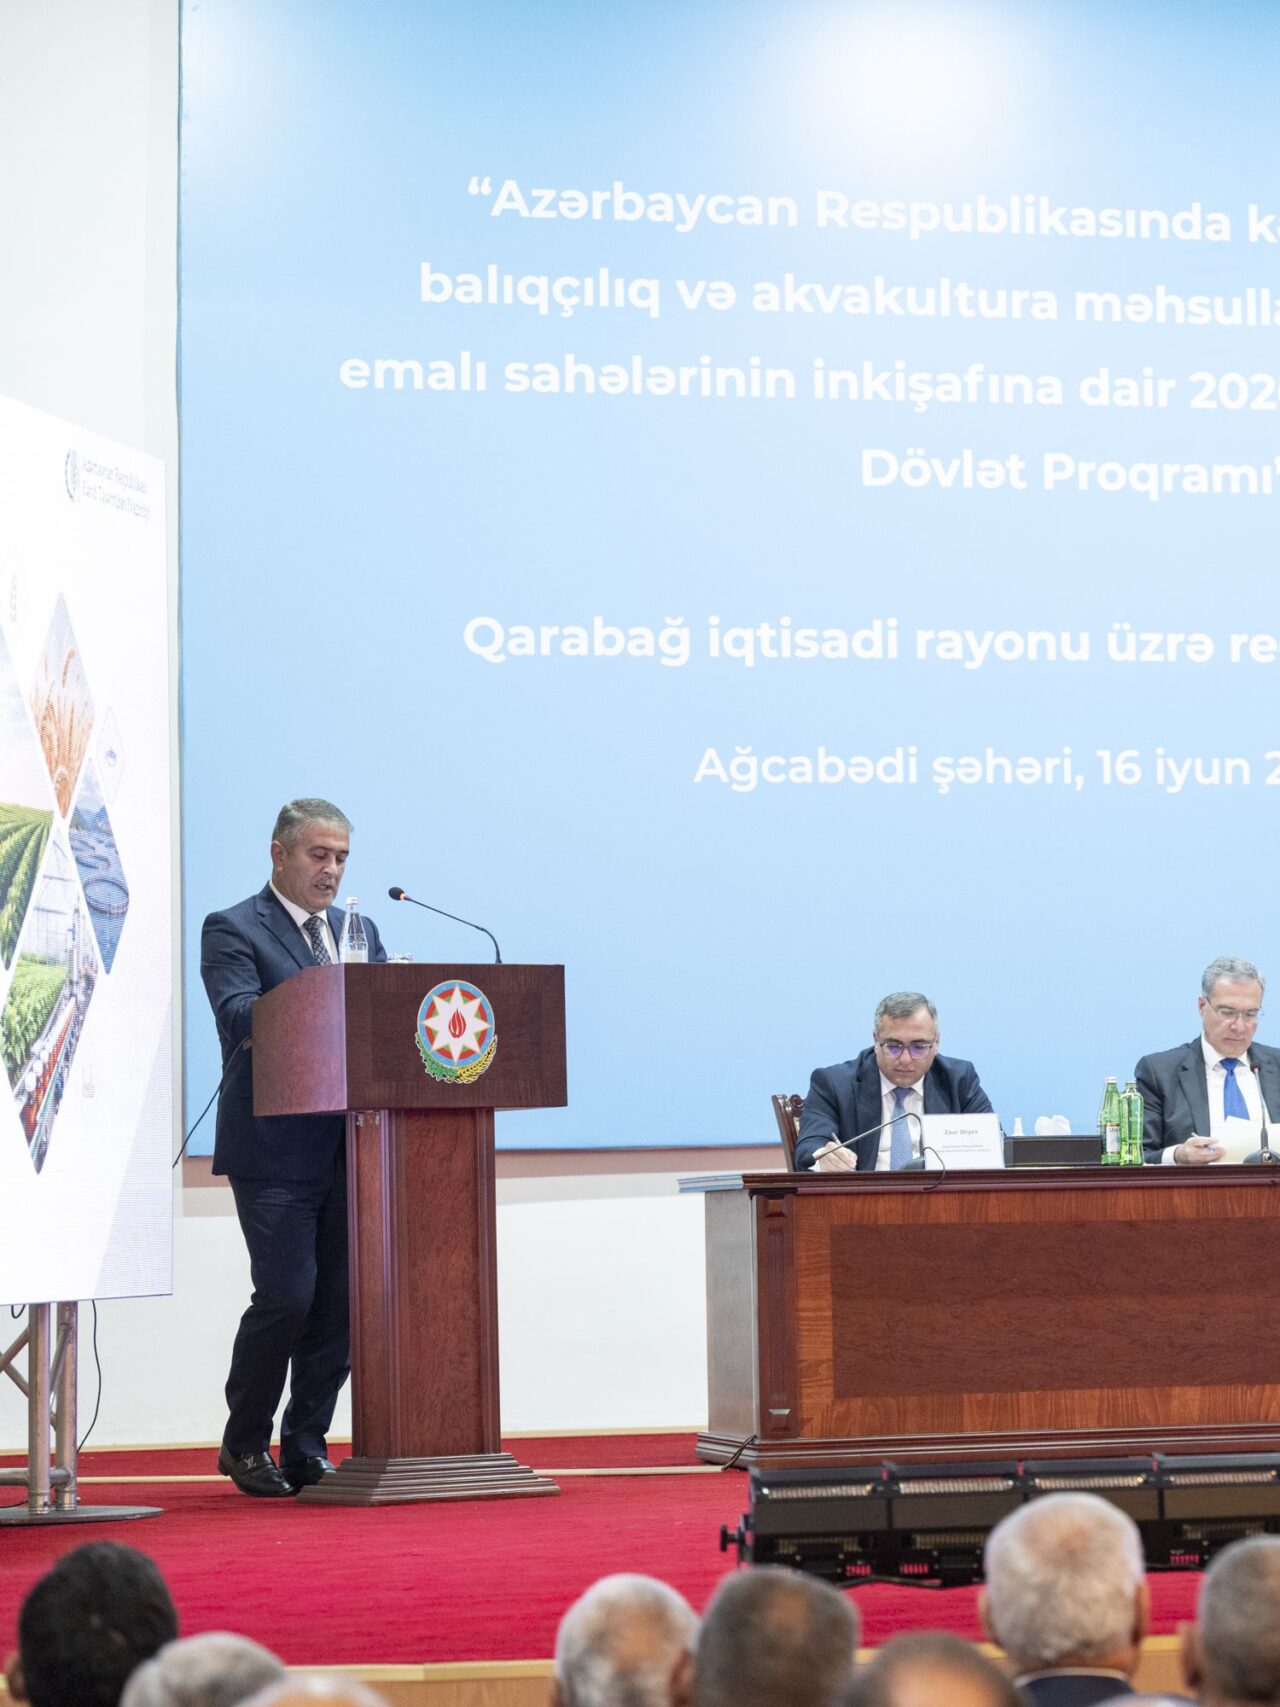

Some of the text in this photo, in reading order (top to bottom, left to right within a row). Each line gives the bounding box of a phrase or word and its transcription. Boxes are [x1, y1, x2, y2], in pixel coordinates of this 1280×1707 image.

[468, 176, 798, 233] “Azərbaycan
[817, 192, 1232, 241] Respublikasında
[420, 262, 660, 319] balıqçılıq
[676, 280, 737, 311] və
[753, 273, 1058, 320] akvakultura
[340, 350, 487, 392] emalı
[505, 353, 795, 399] sahələrinin
[815, 357, 1063, 412] inkişafına
[1079, 368, 1176, 407] dair
[863, 448, 1027, 490] Dövlət
[464, 616, 691, 667] Qarabağ
[709, 616, 898, 668] iqtisadi
[917, 630, 1090, 670] rayonu
[1107, 623, 1215, 663] üzrə
[694, 746, 918, 793] Ağcabədi
[933, 747, 1085, 795] şəhəri,
[1097, 750, 1142, 785] 16
[1156, 747, 1251, 794] iyun
